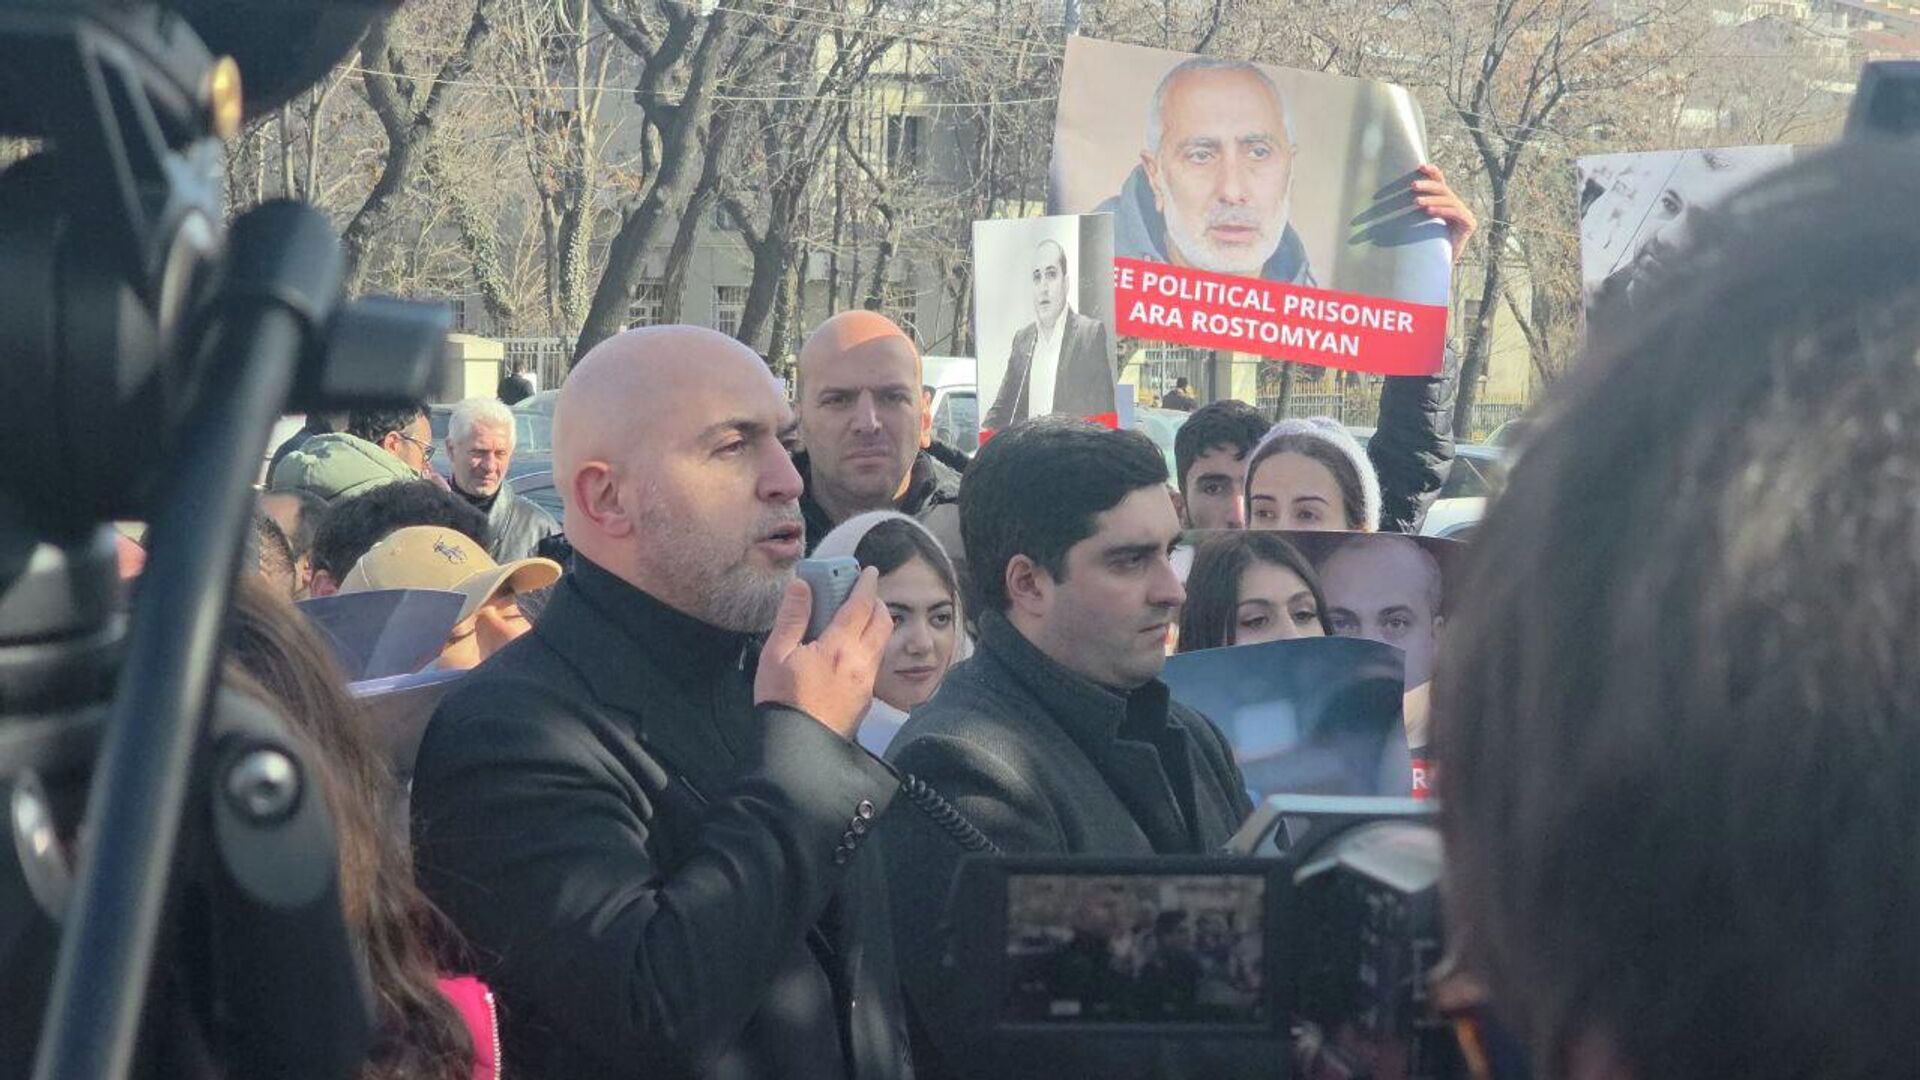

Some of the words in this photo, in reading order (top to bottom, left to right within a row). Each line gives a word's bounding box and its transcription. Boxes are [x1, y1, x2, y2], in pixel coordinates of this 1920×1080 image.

[1129, 301, 1184, 328] ARA
[1191, 311, 1360, 356] ROSTOMYAN
[1142, 271, 1277, 313] POLITICAL
[1283, 294, 1414, 332] PRISONER
